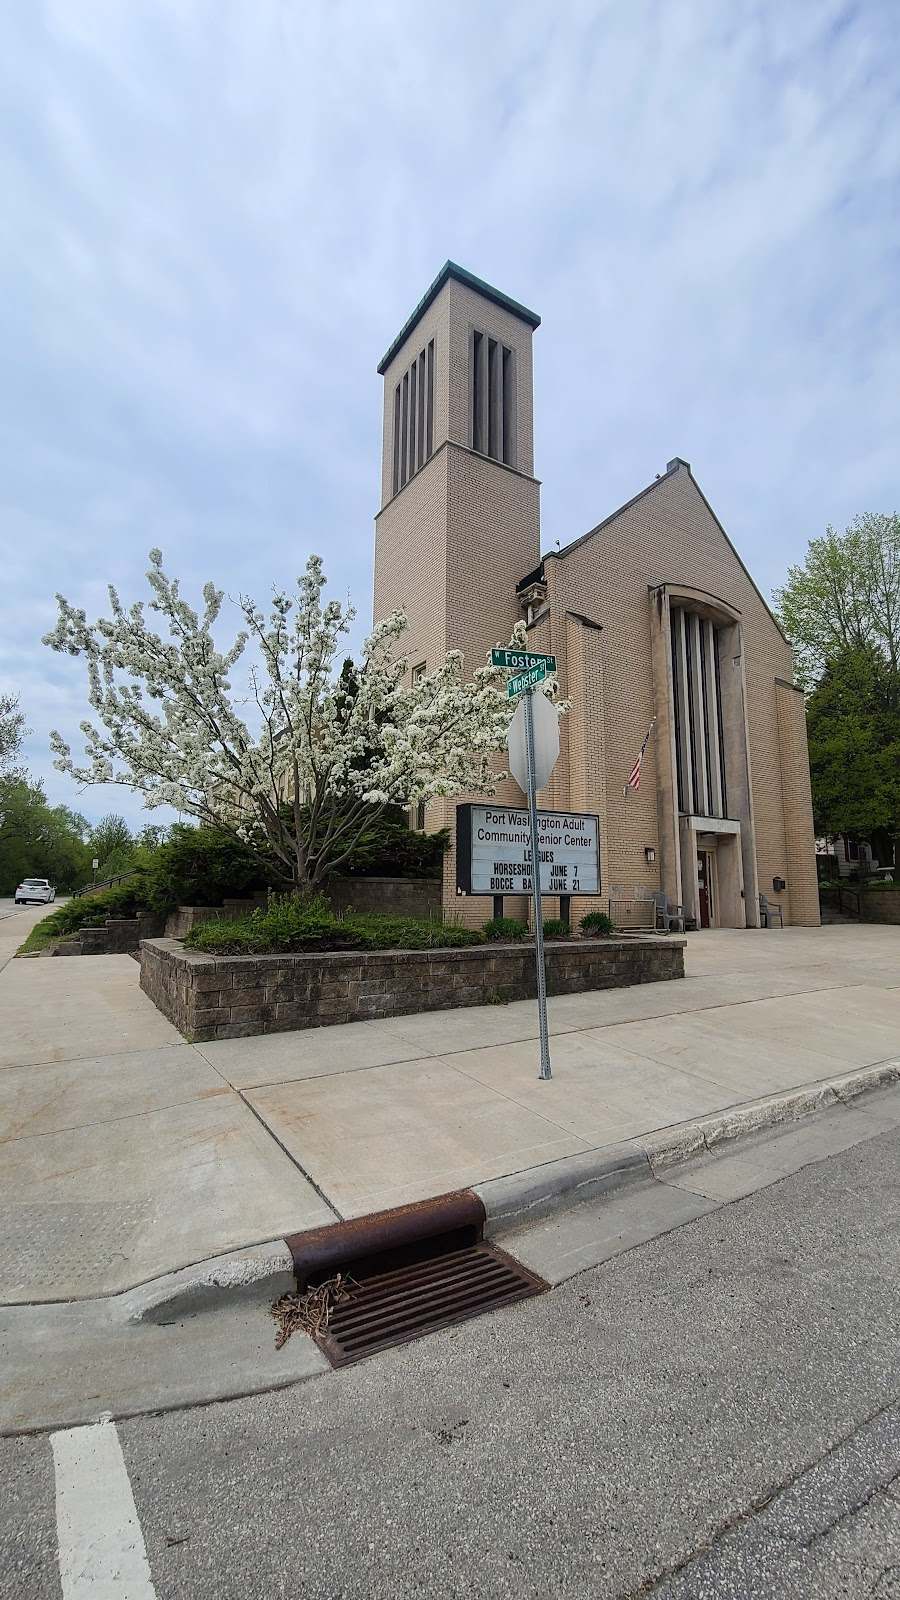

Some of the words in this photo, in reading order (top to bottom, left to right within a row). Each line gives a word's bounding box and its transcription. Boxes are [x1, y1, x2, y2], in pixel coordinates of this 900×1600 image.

[505, 652, 542, 666] Foster
[513, 670, 539, 693] Webster
[485, 812, 506, 825] Port
[508, 814, 561, 831] Wasngton
[562, 819, 585, 830] Adult
[478, 828, 531, 846] Community
[534, 833, 562, 845] enior
[564, 834, 592, 847] Center
[524, 850, 554, 863] LEGUES
[550, 866, 568, 876] JUNE
[574, 866, 578, 877] 7
[490, 878, 514, 889] BOCCE
[549, 879, 567, 890] JUNE
[573, 880, 580, 891] 21
